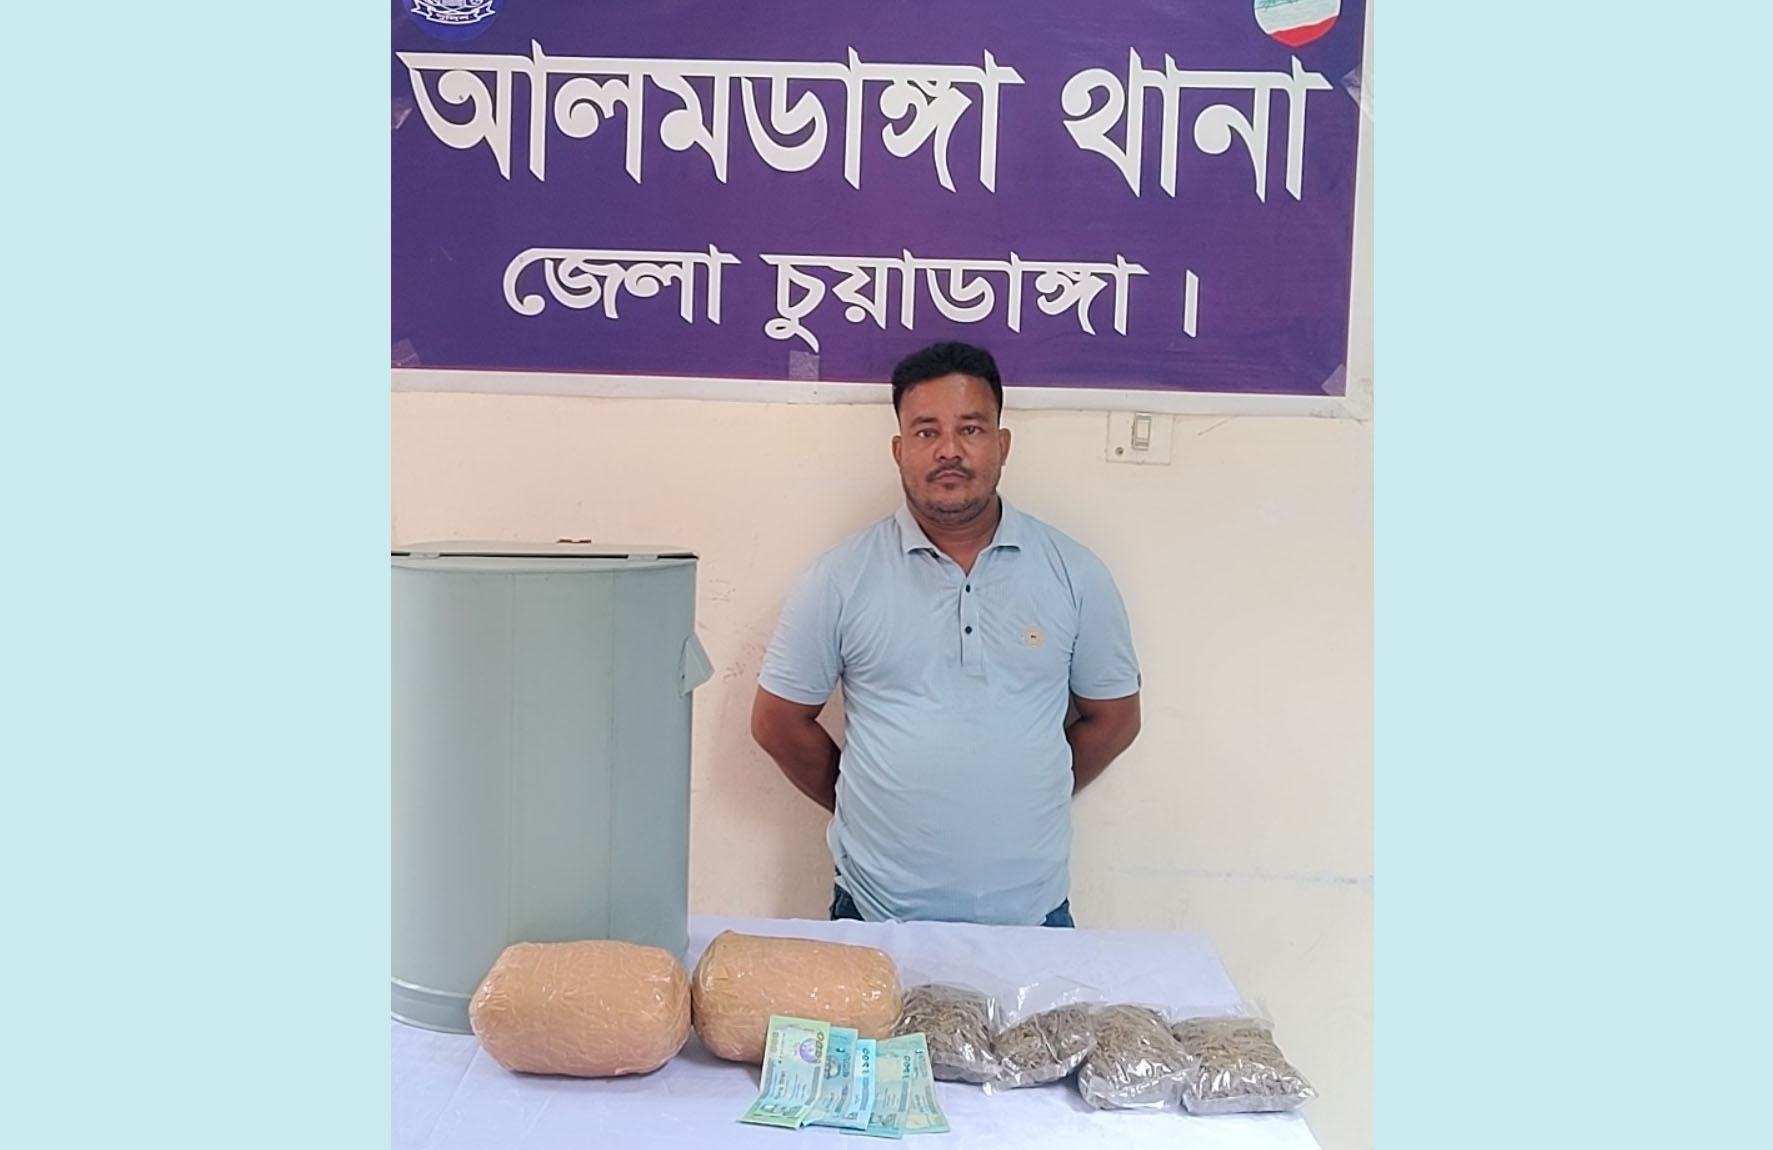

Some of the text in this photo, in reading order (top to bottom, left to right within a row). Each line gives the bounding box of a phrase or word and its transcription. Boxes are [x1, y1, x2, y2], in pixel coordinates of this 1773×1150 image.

[396, 39, 1333, 203] আলমডাঙ্গা থানা
[503, 244, 742, 325] জেলা
[759, 248, 1150, 353] চুয়াডাঙ্গা
